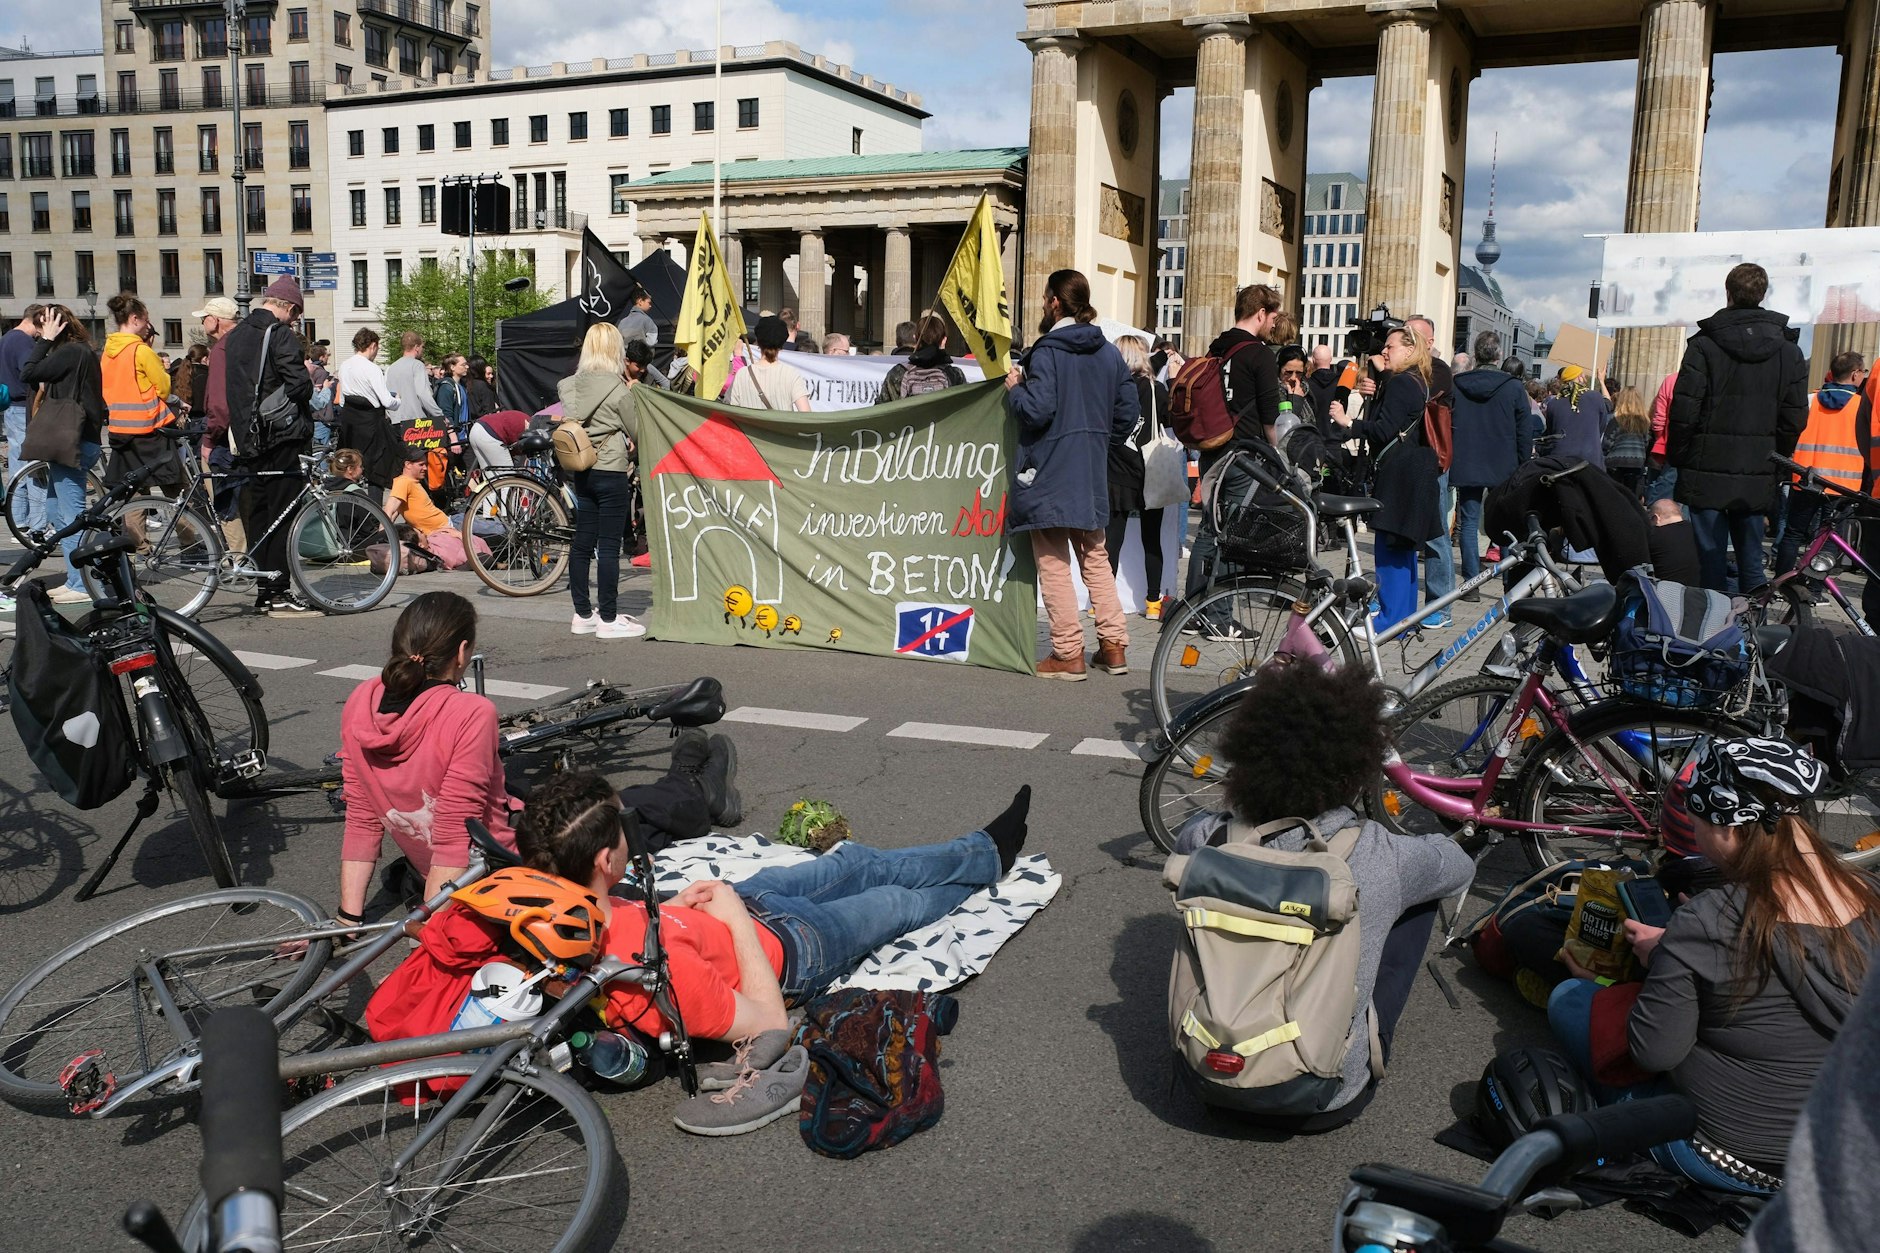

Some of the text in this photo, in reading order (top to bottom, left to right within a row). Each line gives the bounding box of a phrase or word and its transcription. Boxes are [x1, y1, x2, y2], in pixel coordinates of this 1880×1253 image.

[403, 425, 445, 443] Capitalism
[414, 418, 433, 428] Burn
[798, 501, 948, 538] investieren
[807, 542, 1017, 603] in BETON!
[920, 611, 950, 651] 14
[1434, 606, 1499, 670] Kalkhoff
[1583, 924, 1610, 940] CHIPS
[1488, 1085, 1503, 1111] GIRO
